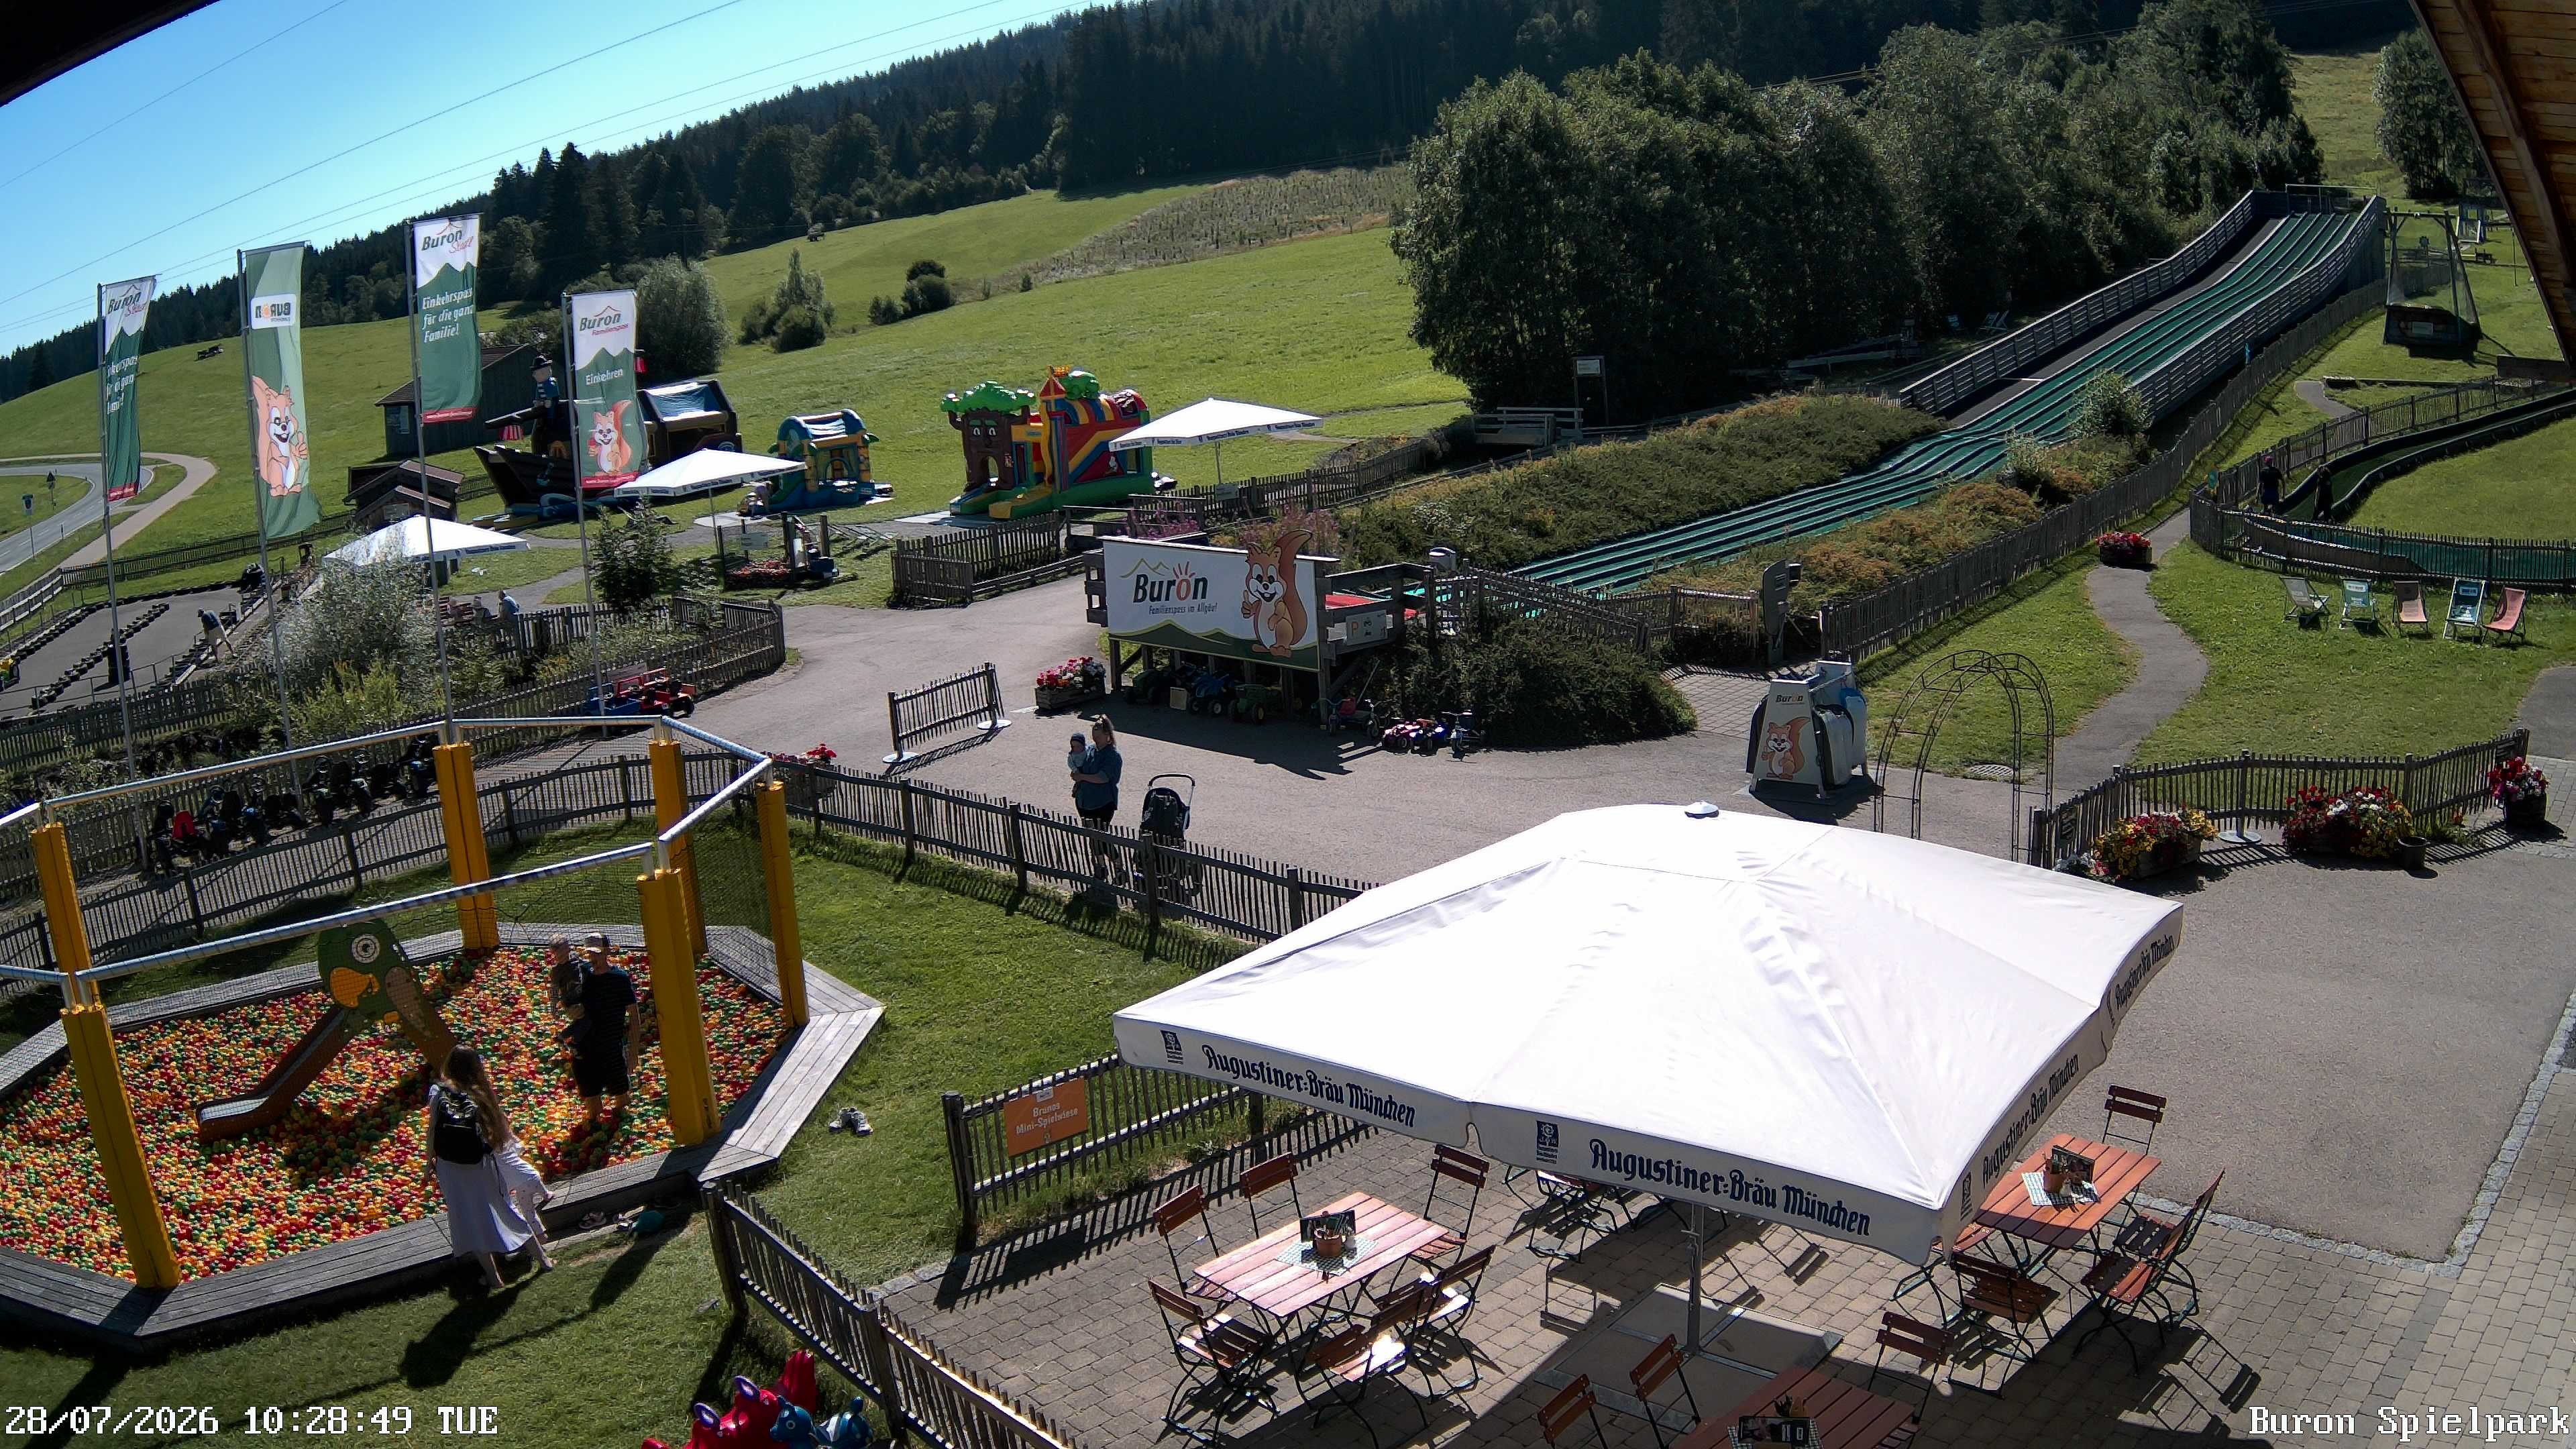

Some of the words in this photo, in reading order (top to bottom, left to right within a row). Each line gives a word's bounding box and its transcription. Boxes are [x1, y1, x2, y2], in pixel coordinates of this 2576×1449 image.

[422, 230, 462, 251] Buron
[107, 292, 142, 315] Buron
[422, 314, 437, 330] für
[438, 309, 452, 322] die
[580, 313, 621, 331] Buron
[586, 368, 623, 386] Einkehren
[1133, 574, 1208, 603] Buron
[2048, 1054, 2079, 1104] München
[1032, 1102, 1061, 1117] Brunos
[1346, 1081, 1416, 1128] München
[1016, 1108, 1079, 1134] Mini-Spielwiese
[1782, 1184, 1870, 1236] München
